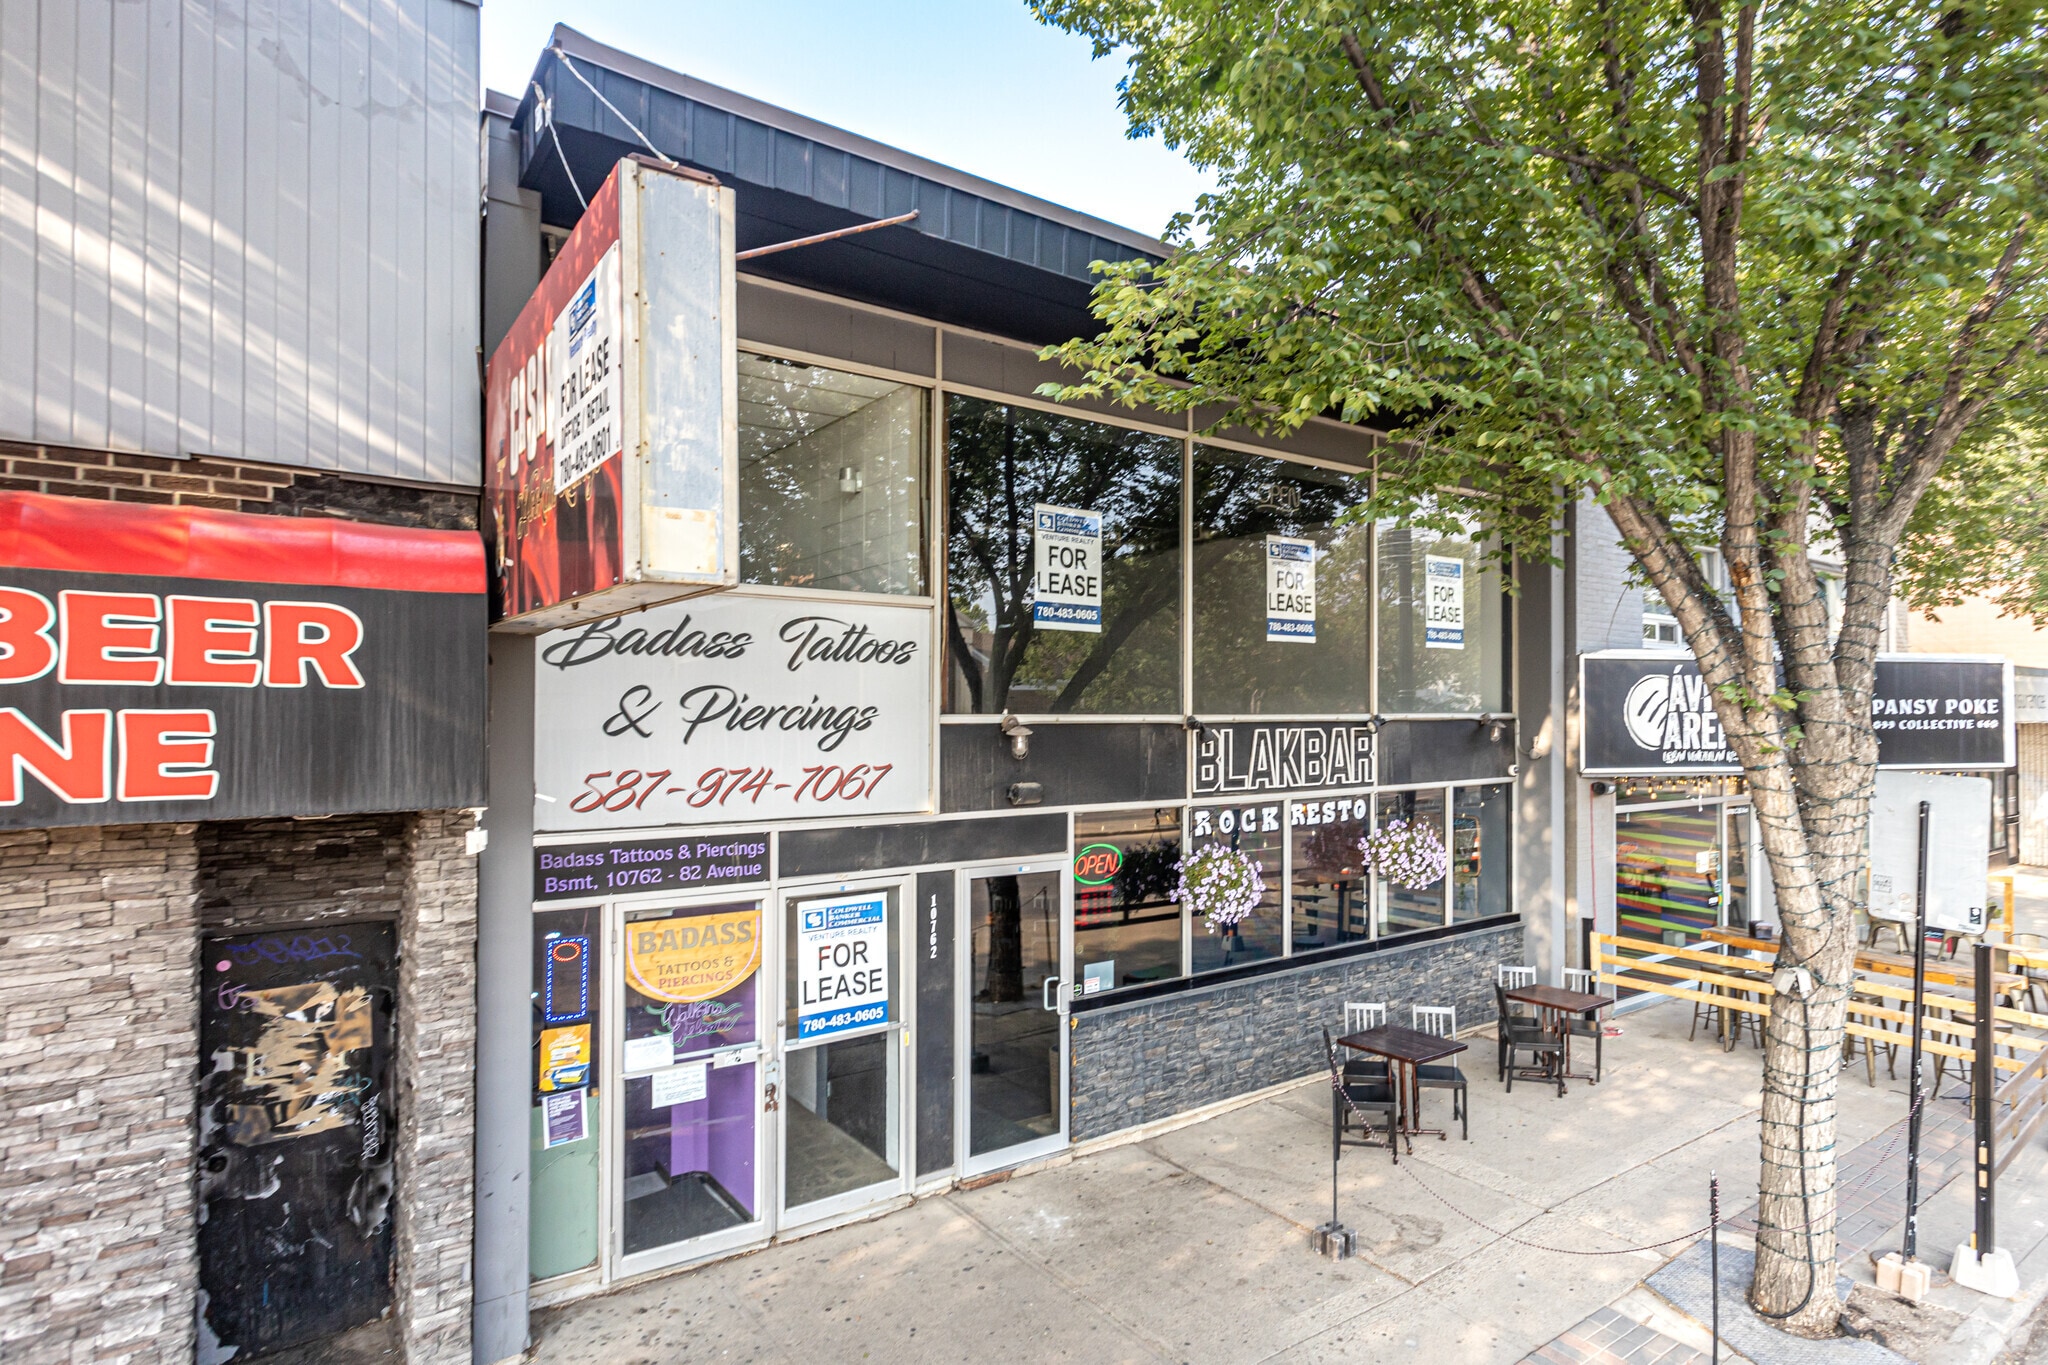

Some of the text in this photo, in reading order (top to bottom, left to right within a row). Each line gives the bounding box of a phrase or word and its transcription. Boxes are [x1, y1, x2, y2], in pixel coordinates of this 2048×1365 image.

[560, 372, 577, 418] FOR
[580, 336, 609, 400] LEASE
[587, 386, 609, 428] RETAIL
[1048, 545, 1087, 570] FOR
[1037, 571, 1098, 598] LEASE
[1276, 570, 1304, 591] FOR
[1268, 592, 1312, 614] LEASE
[1433, 585, 1455, 603] FOR
[1036, 606, 1098, 621] 780-483-0605
[1426, 605, 1461, 623] LEASE
[0, 586, 365, 689] BEER
[541, 613, 919, 672] Badass Tattoos
[602, 684, 880, 752] & Piercings
[1871, 699, 1939, 715] PANSY
[1945, 699, 1999, 715] POKE
[1899, 719, 1975, 730] COLLECTIVE
[1192, 727, 1376, 793] BLAKBAR
[569, 763, 893, 814] 587-974-7067
[1194, 799, 1367, 837] ROCK RESTO
[540, 841, 765, 870] Badass Tattoos & Piercings
[1074, 853, 1118, 876] OPEN
[606, 868, 662, 888] 10762
[679, 865, 702, 882] 82
[706, 862, 762, 879] Avenue
[828, 904, 873, 915] COLDWELL
[828, 912, 861, 922] BANKER
[828, 916, 882, 928] COMMERCIAL
[637, 920, 751, 955] BADASS
[808, 926, 877, 942] VENTURE REALTY
[930, 893, 938, 960] 10762
[657, 955, 735, 976] TATTOOS &
[818, 940, 868, 971] FOR
[657, 969, 734, 989] PIERCINGS
[803, 968, 883, 1005] LEASE
[803, 1006, 884, 1033] 780-483-0605
